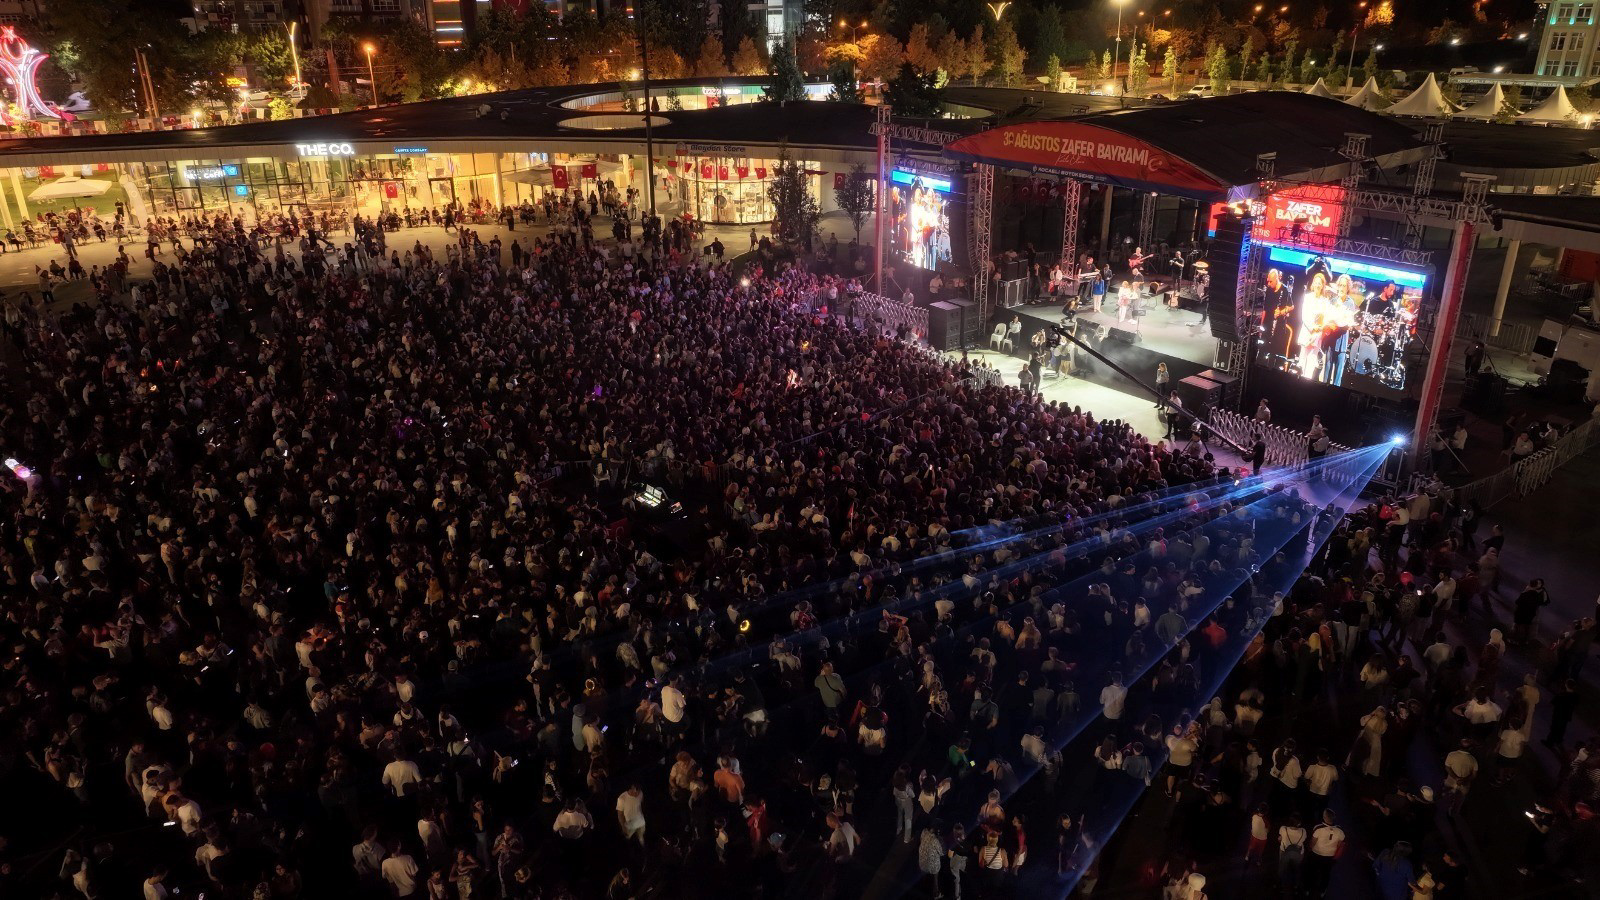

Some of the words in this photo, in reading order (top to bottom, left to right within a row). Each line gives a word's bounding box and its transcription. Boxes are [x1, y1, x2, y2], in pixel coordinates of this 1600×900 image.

[296, 144, 328, 156] THE
[328, 143, 355, 155] CO.
[1015, 129, 1060, 153] AĞUSTOS
[1060, 138, 1095, 157] ZAFER
[1096, 143, 1149, 166] BAYRAMI
[1286, 200, 1322, 217] ZAFER
